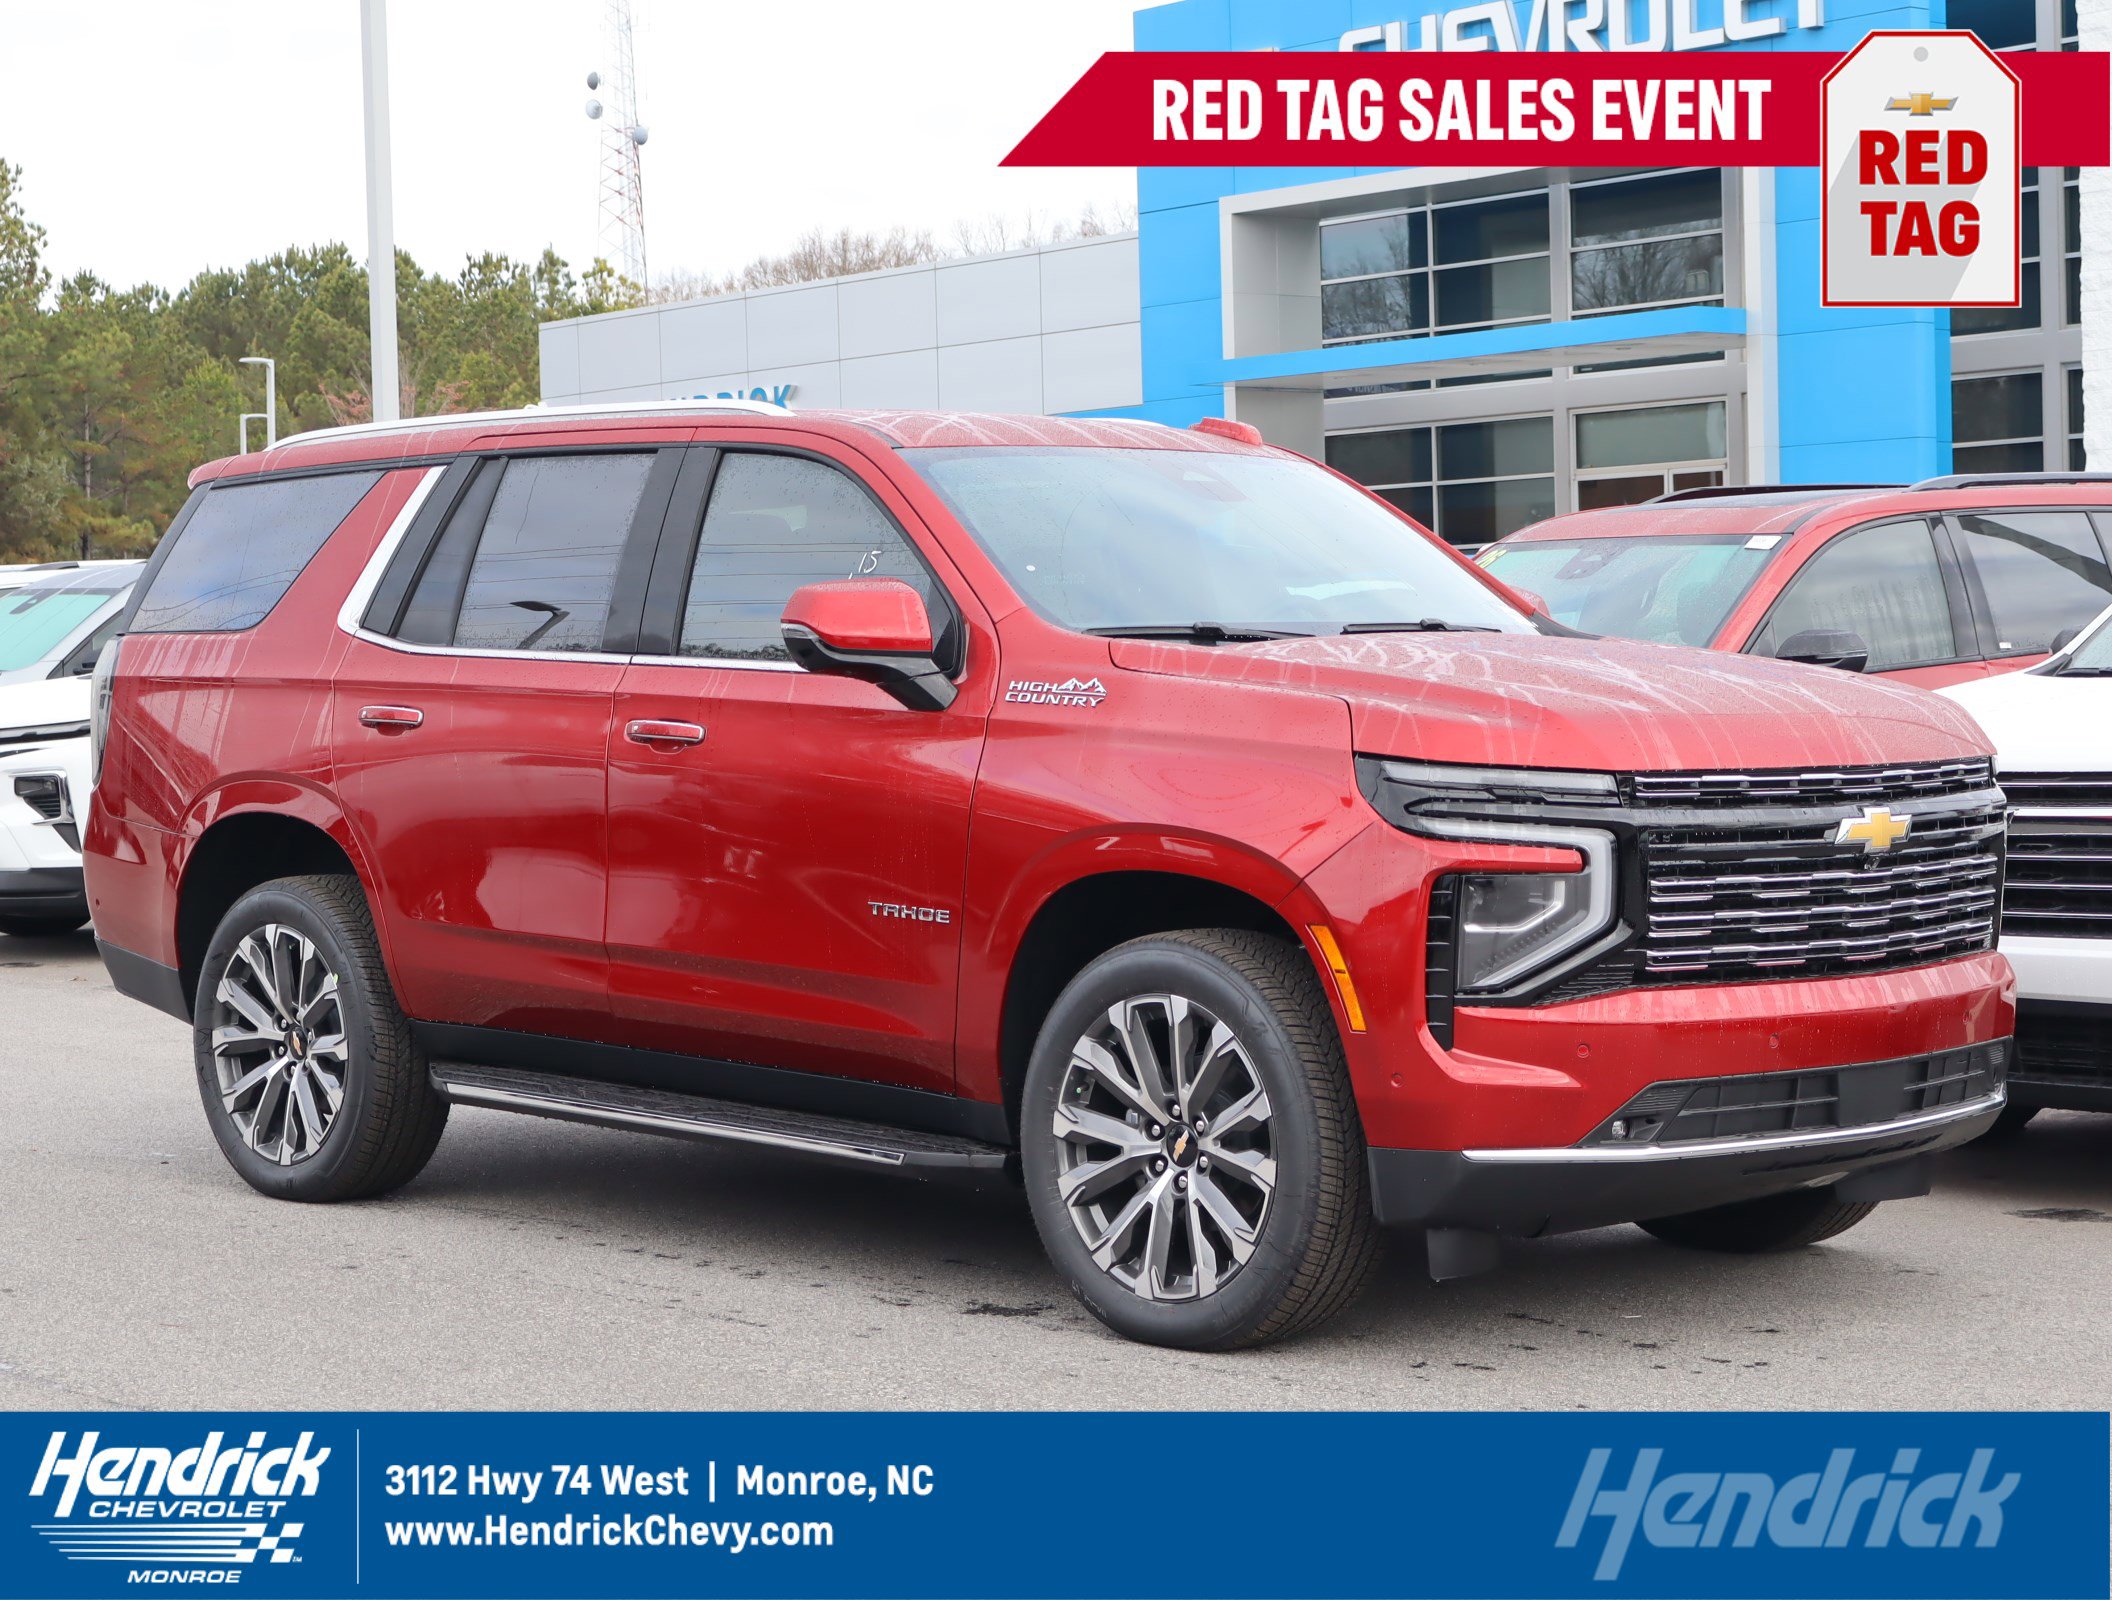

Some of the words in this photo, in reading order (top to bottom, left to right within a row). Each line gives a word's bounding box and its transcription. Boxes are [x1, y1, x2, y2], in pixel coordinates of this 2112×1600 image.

[1008, 680, 1059, 693] HIGH
[1005, 691, 1105, 708] COUNTRY
[867, 901, 951, 924] TAHOE
